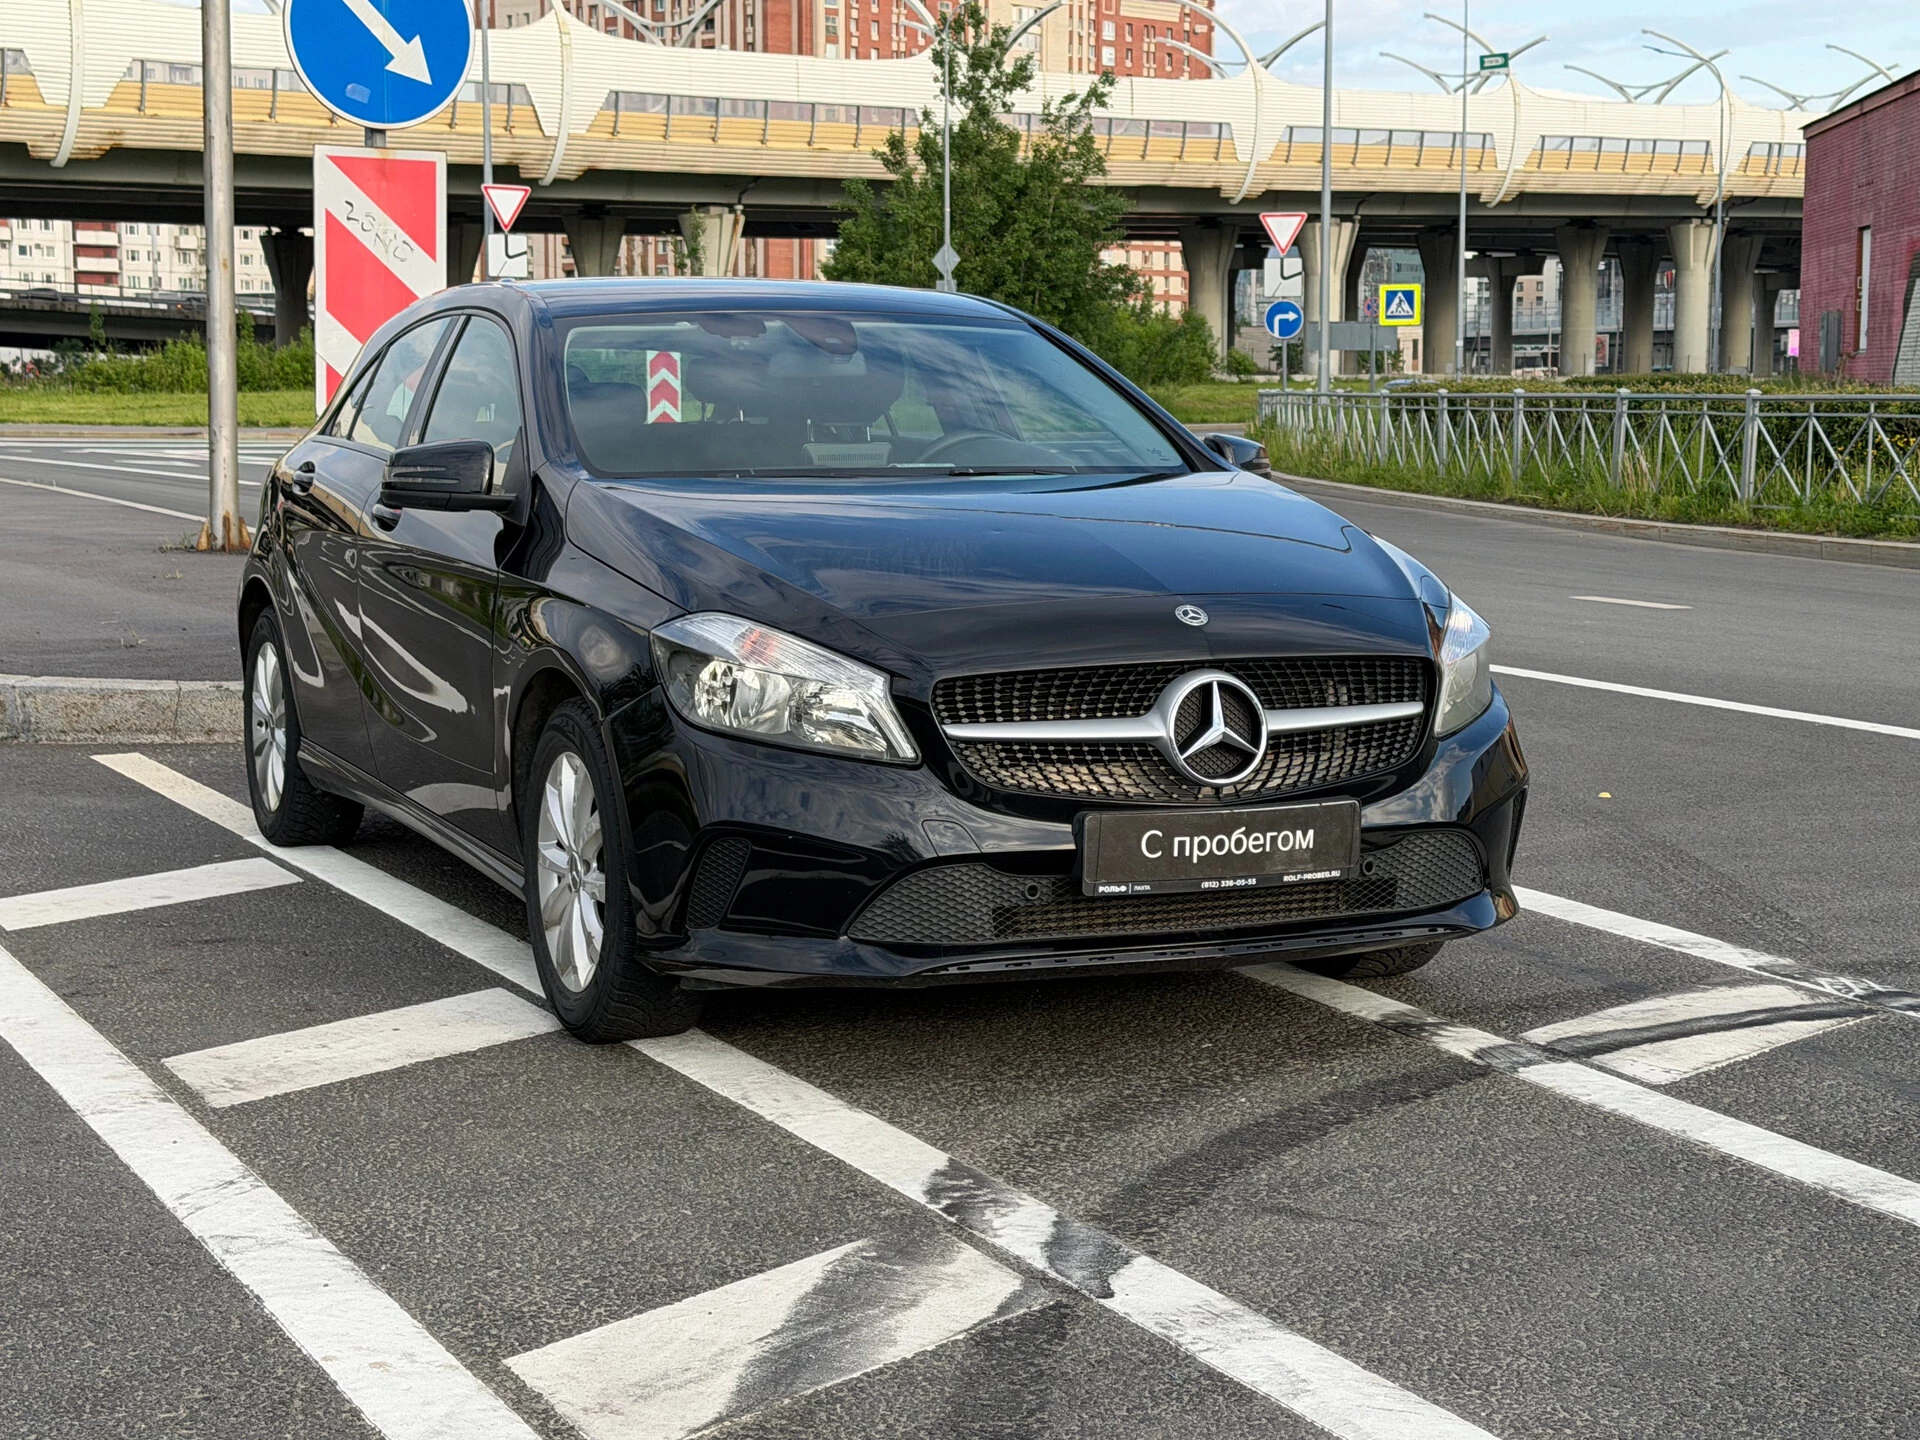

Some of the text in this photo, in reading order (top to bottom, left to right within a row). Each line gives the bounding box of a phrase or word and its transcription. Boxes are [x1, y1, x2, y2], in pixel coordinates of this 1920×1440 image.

[1141, 826, 1315, 864] С пробегом
[1283, 869, 1341, 882] ROLF-PROBEG.RU
[1098, 885, 1128, 893] РОЛЬФ
[1201, 878, 1257, 889] (812) 336-05-55
